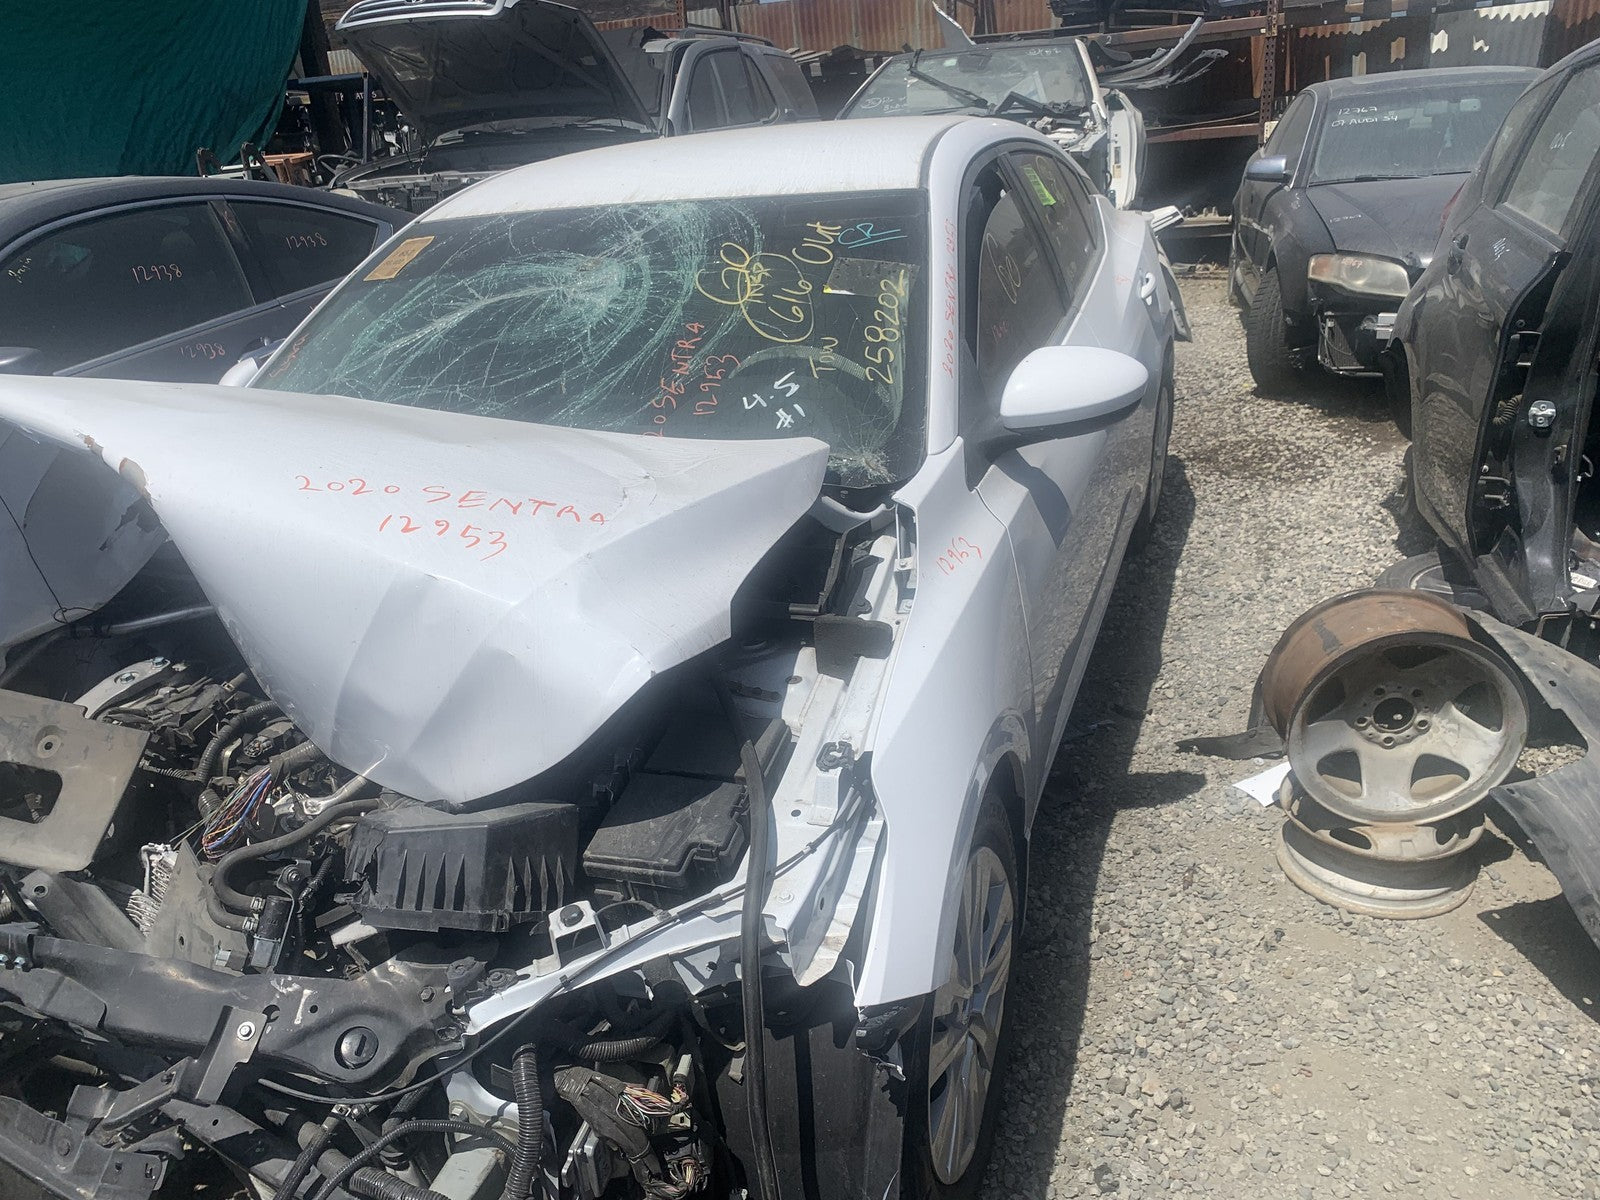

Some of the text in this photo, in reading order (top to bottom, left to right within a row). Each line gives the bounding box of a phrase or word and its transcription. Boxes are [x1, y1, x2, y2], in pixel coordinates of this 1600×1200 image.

[1331, 120, 1345, 128] 07
[1349, 117, 1378, 126] AUDI
[1338, 106, 1378, 116] 12767
[284, 232, 328, 250] 12938
[132, 263, 183, 284] 12938
[768, 280, 813, 323] 616
[864, 269, 905, 385] 258202
[180, 342, 226, 360] 12938
[652, 322, 705, 410] SENTRA
[692, 354, 741, 415] 12953
[775, 403, 806, 430] #1
[295, 474, 610, 526] 2020 SENTRA
[378, 514, 508, 562] 12953
